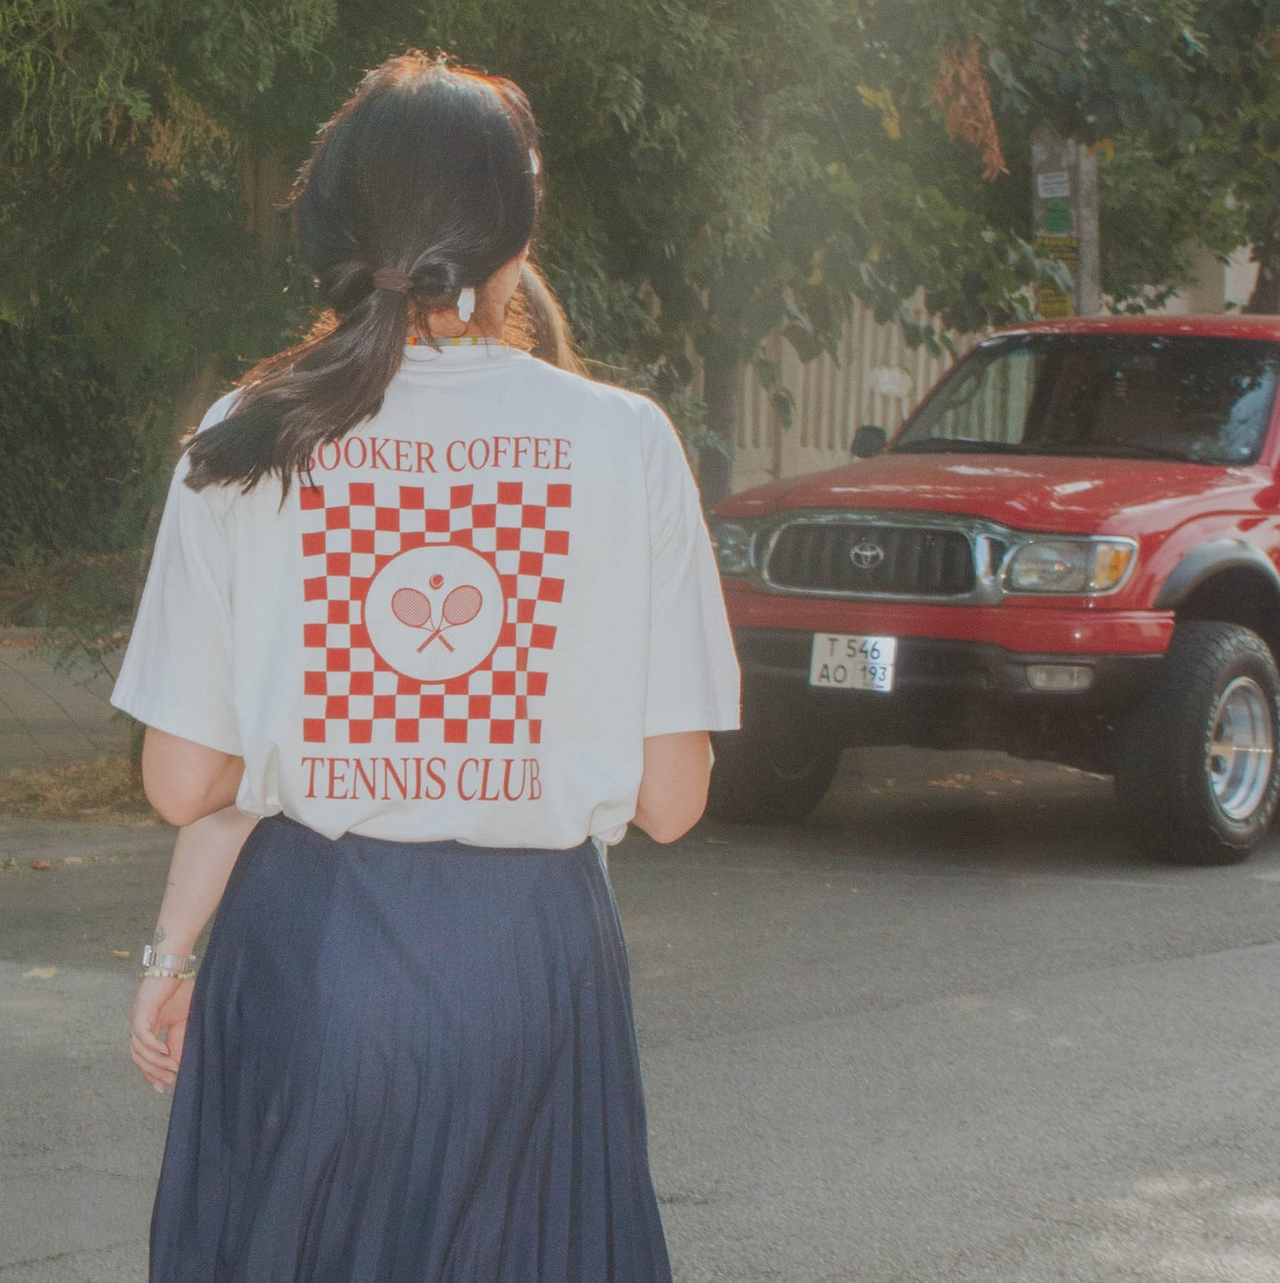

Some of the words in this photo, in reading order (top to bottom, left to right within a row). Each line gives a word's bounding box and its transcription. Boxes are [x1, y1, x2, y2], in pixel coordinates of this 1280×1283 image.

[445, 436, 572, 472] COFFEE
[846, 638, 881, 660] 546
[858, 665, 887, 682] 193
[300, 756, 447, 801] TENNIS
[457, 757, 543, 802] CLUB
